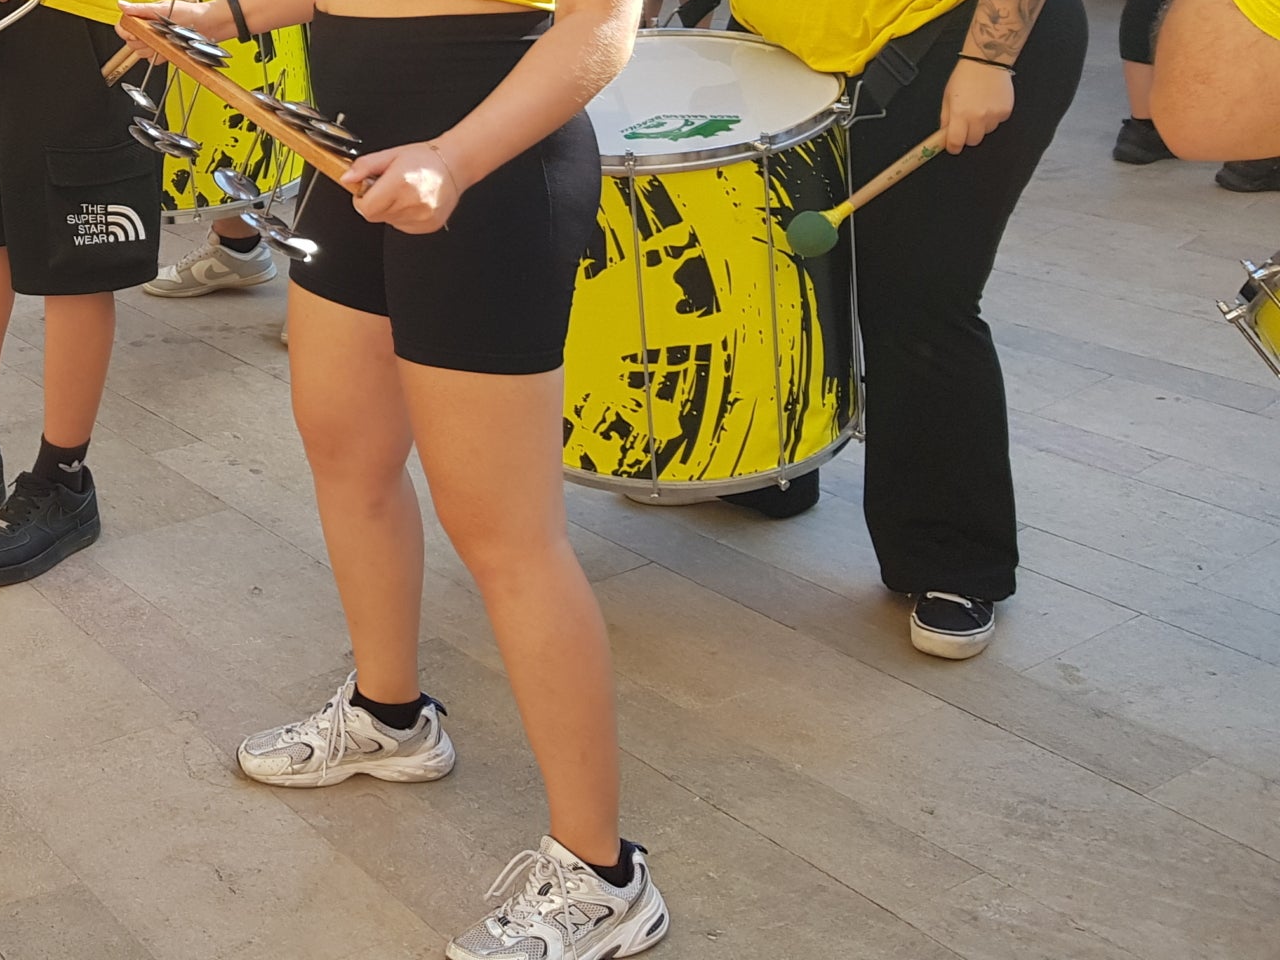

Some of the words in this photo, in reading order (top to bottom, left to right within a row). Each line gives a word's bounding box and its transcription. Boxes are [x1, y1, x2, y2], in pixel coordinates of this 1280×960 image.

[80, 203, 106, 214] THE
[66, 214, 106, 224] SUPER
[78, 224, 106, 234] STAR
[73, 234, 108, 246] WEAR
